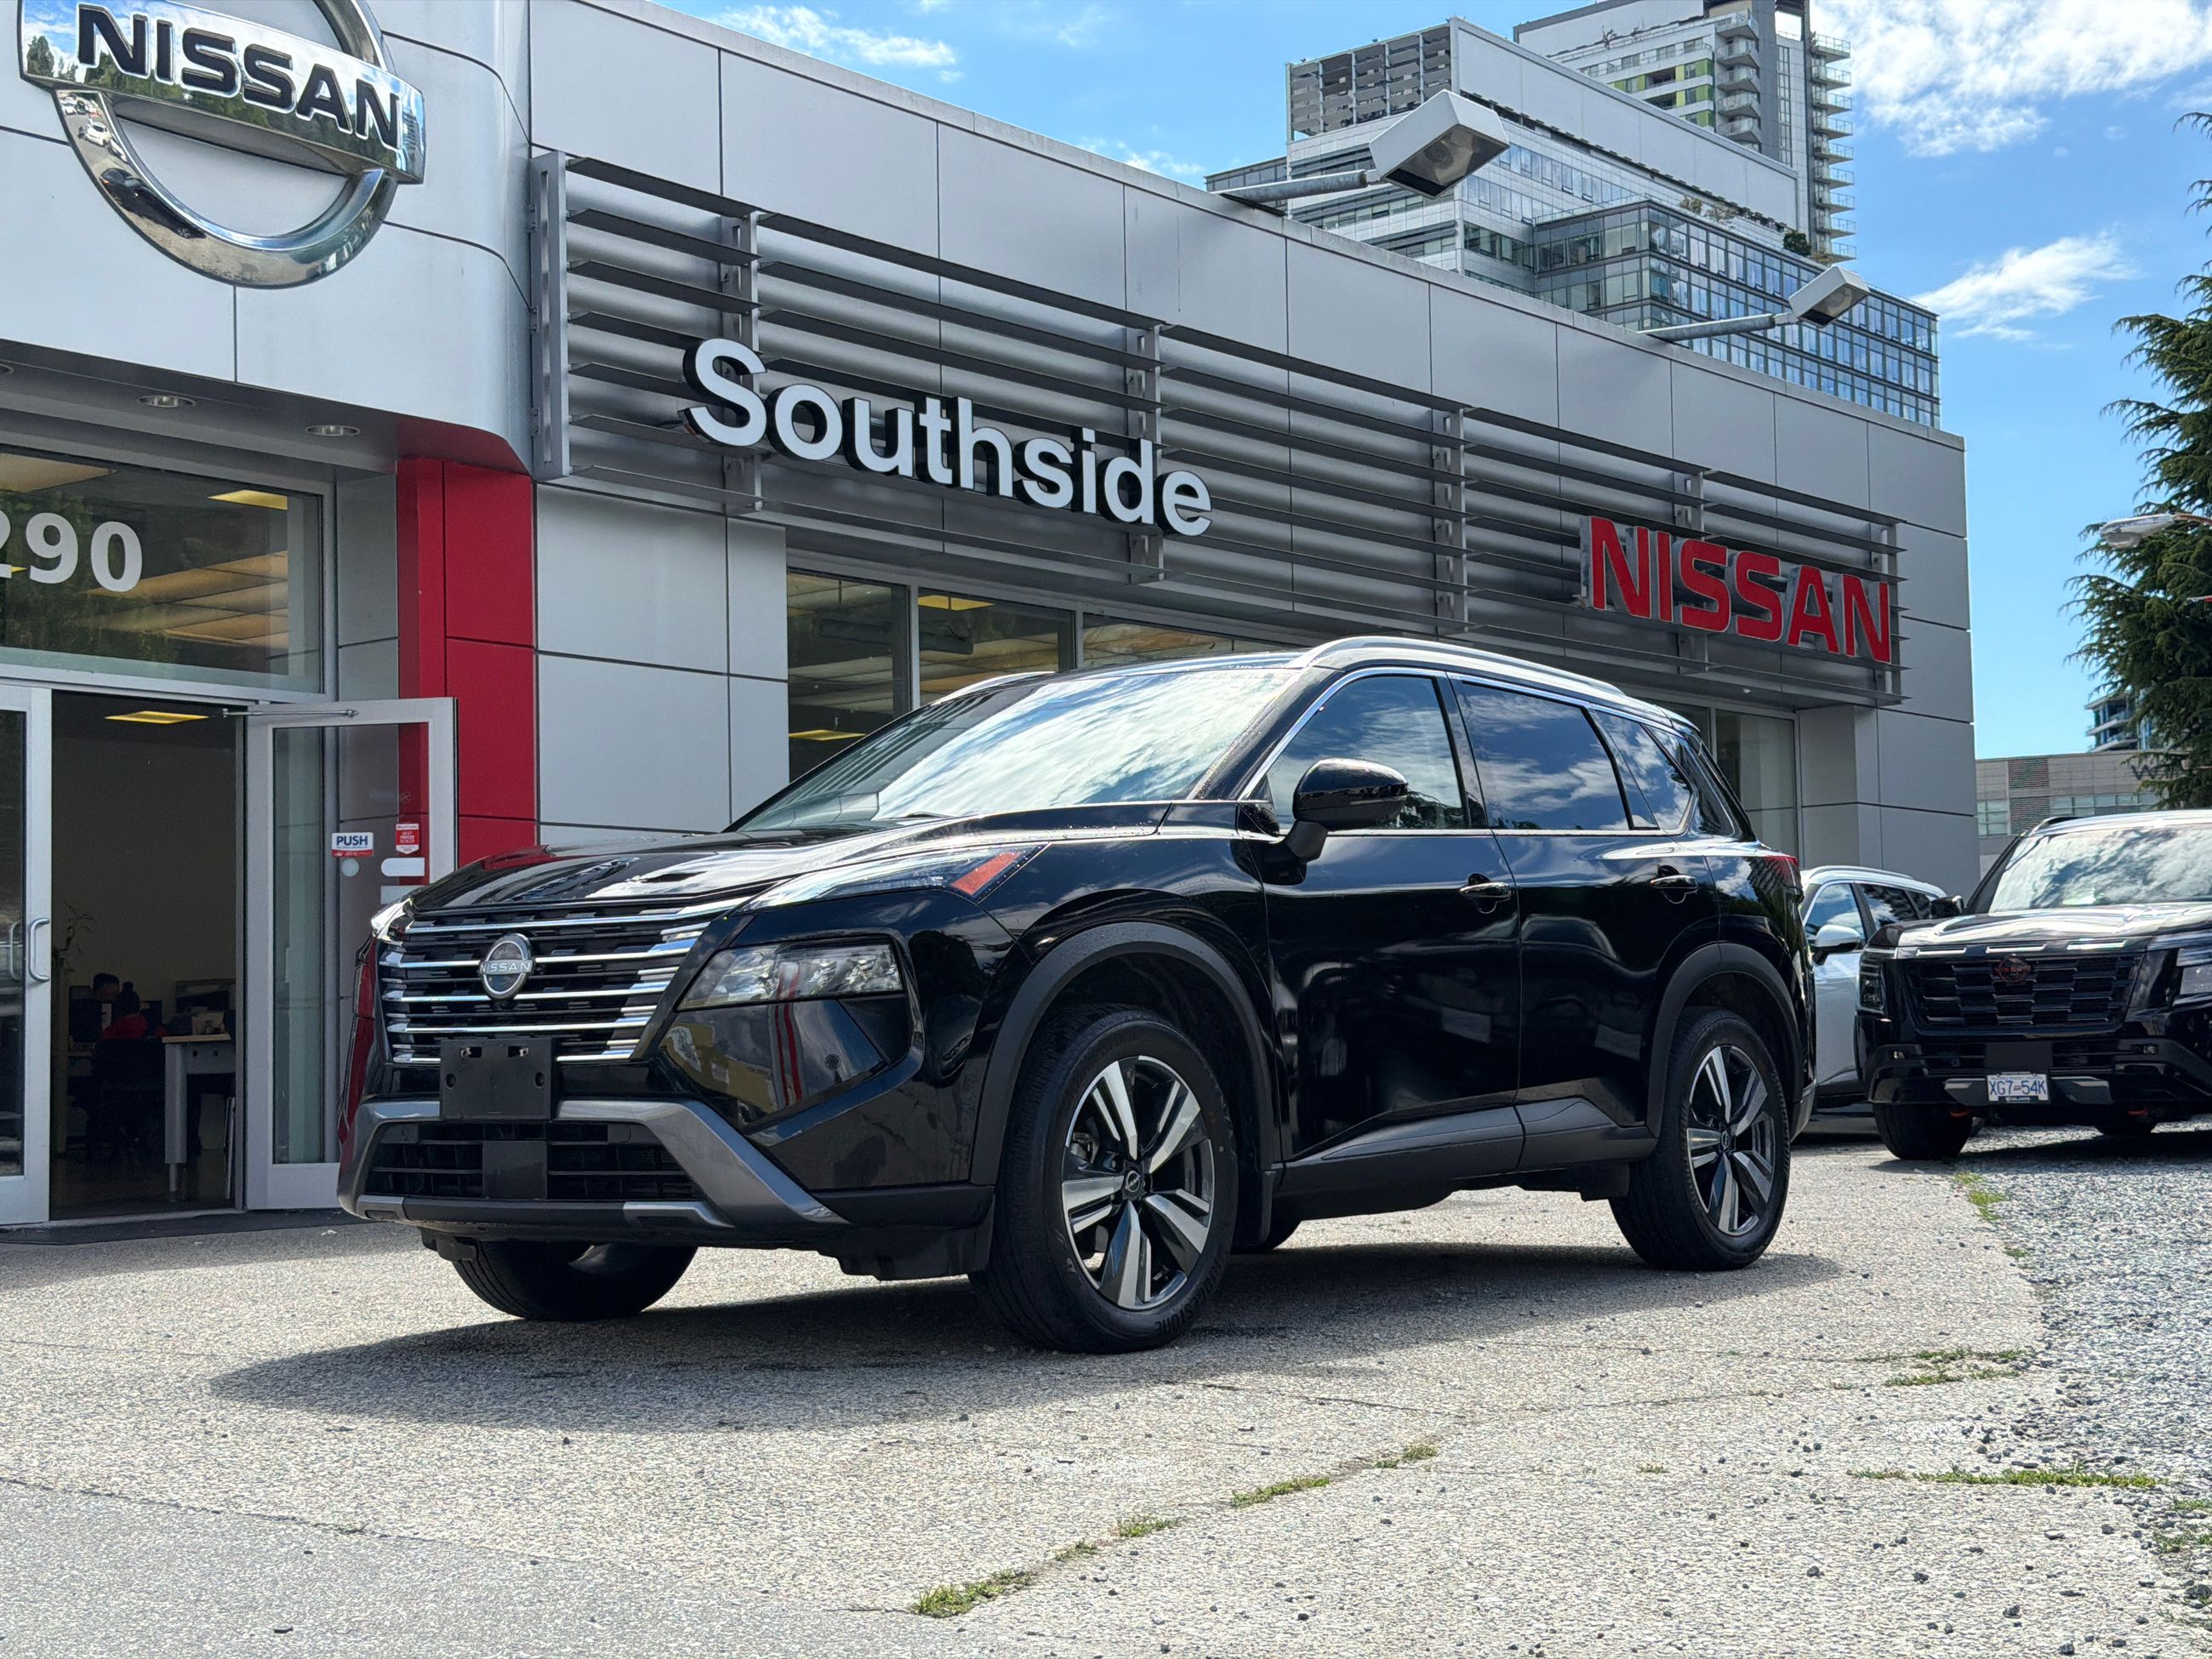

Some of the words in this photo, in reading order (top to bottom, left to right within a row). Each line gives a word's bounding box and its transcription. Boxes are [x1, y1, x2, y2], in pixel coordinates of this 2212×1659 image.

[77, 4, 401, 150] NISSAN
[686, 338, 1212, 536] Southside
[0, 511, 143, 592] 90
[1586, 516, 1891, 664] NISSAN
[336, 835, 368, 846] PUSH
[479, 961, 531, 973] NISSAN
